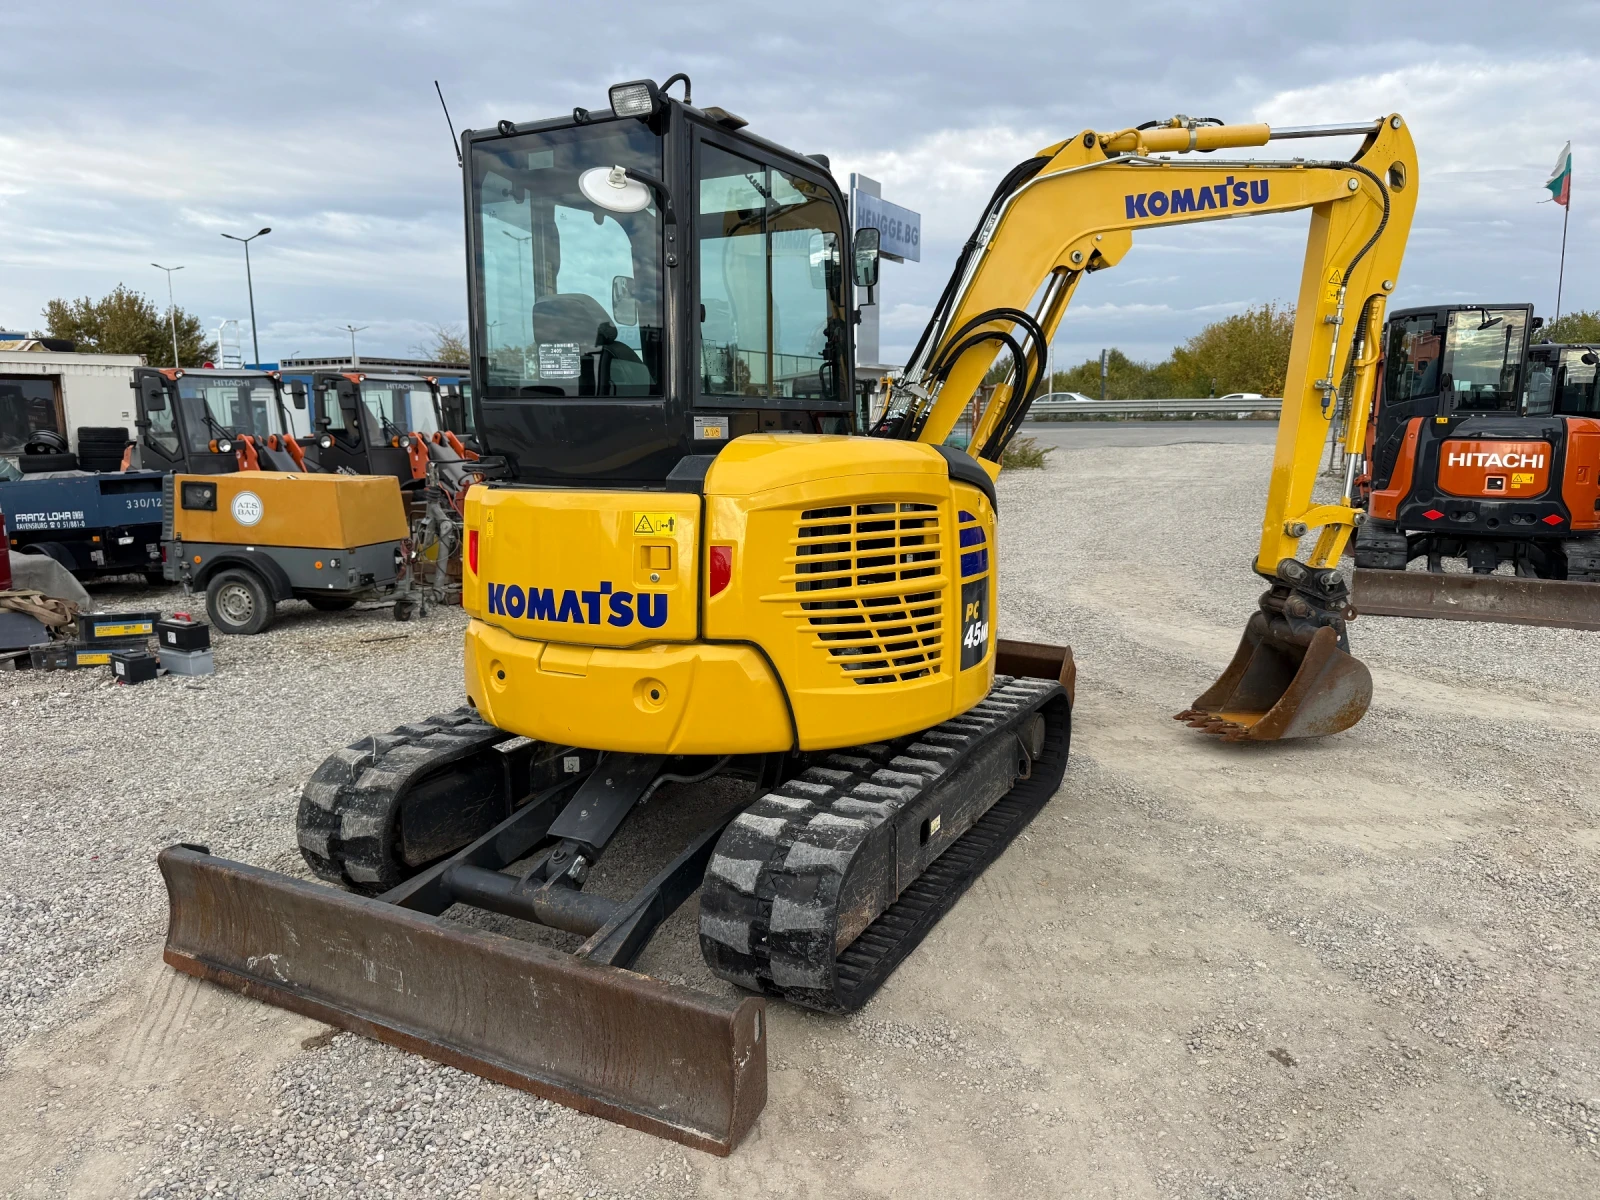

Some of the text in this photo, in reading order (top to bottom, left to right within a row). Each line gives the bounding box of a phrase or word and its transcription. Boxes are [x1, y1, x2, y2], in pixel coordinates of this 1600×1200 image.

[1125, 176, 1269, 219] KOMATSU
[212, 379, 250, 387] HITACHI
[1448, 452, 1544, 469] HITACHI
[126, 498, 163, 509] 330/12
[15, 513, 46, 522] FRANZ
[46, 511, 72, 521] LOHR
[237, 508, 259, 516] BAU
[16, 522, 48, 530] RAVENSBURG
[488, 581, 668, 629] KOMATSU
[965, 600, 980, 622] PC
